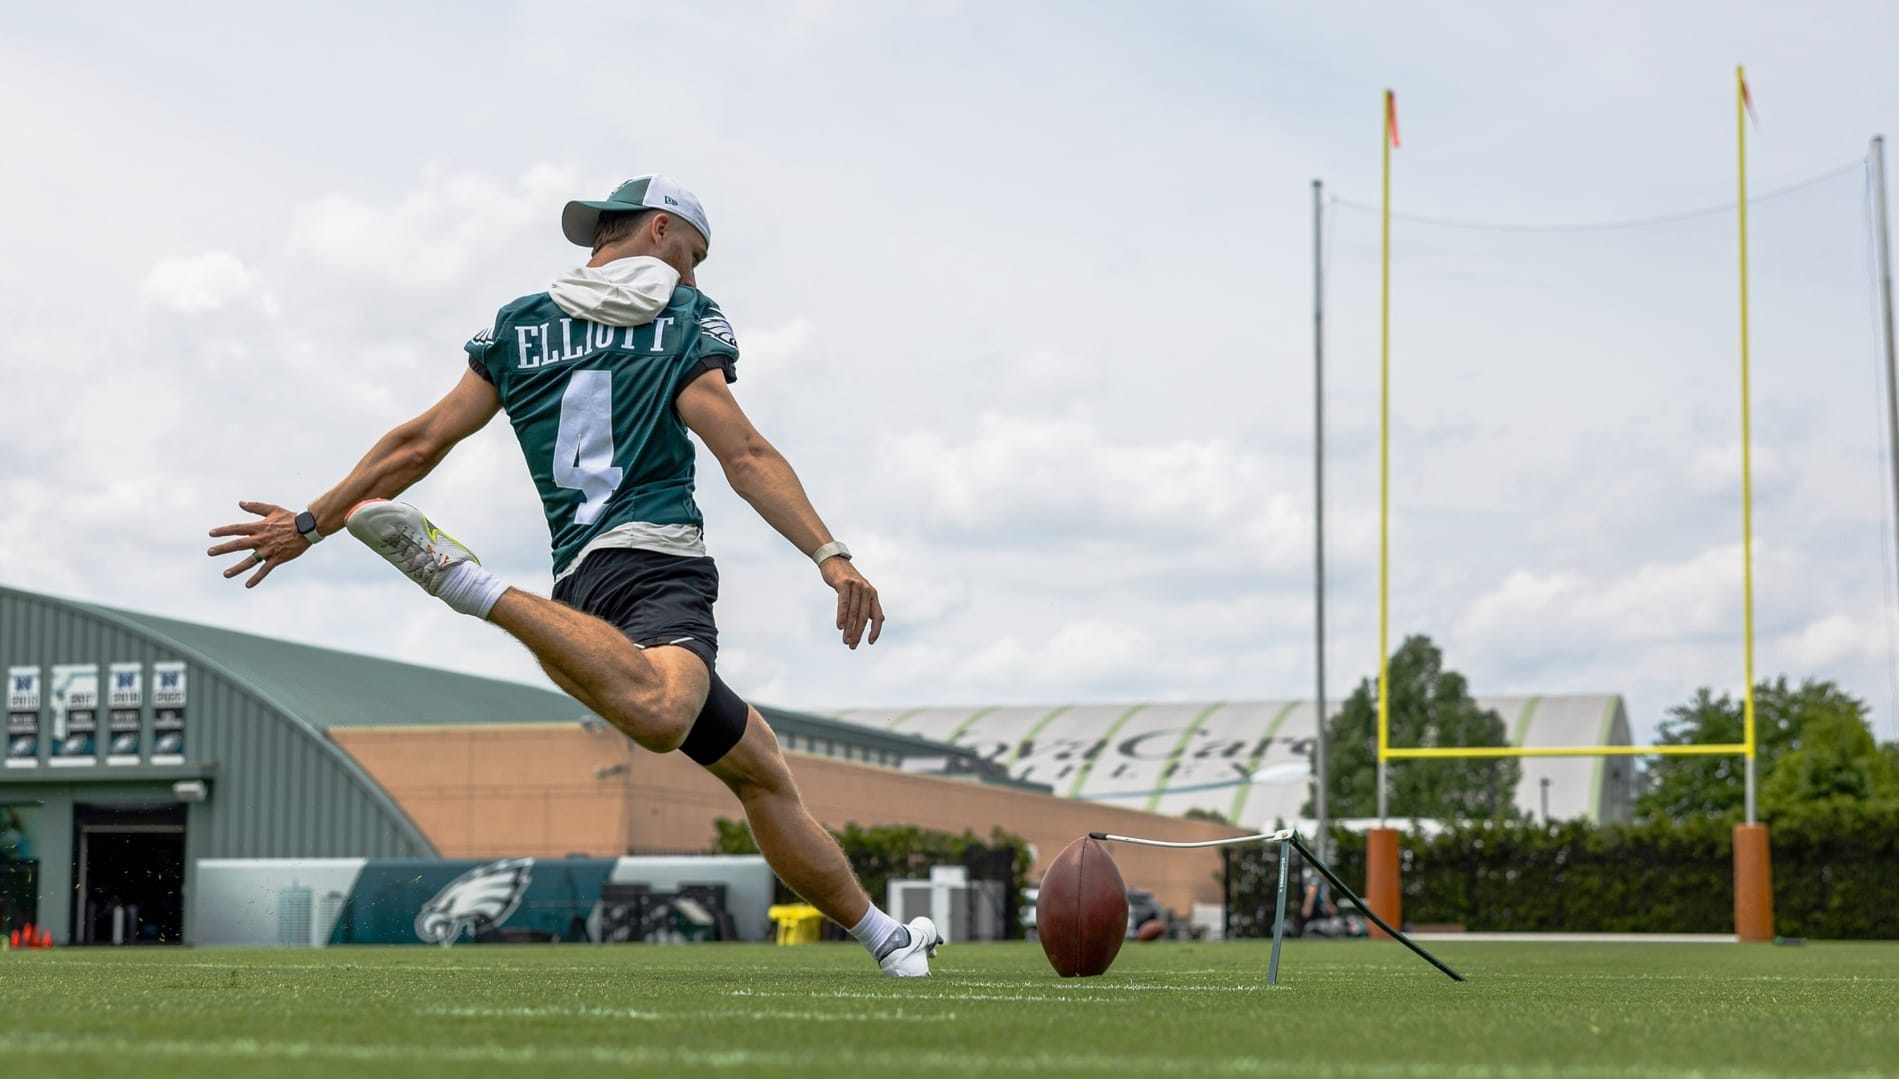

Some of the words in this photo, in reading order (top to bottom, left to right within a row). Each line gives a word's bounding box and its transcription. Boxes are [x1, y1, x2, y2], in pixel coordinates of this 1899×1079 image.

[514, 316, 675, 369] ELLIOTT
[552, 370, 623, 525] 4
[952, 727, 1317, 763] ovaCare
